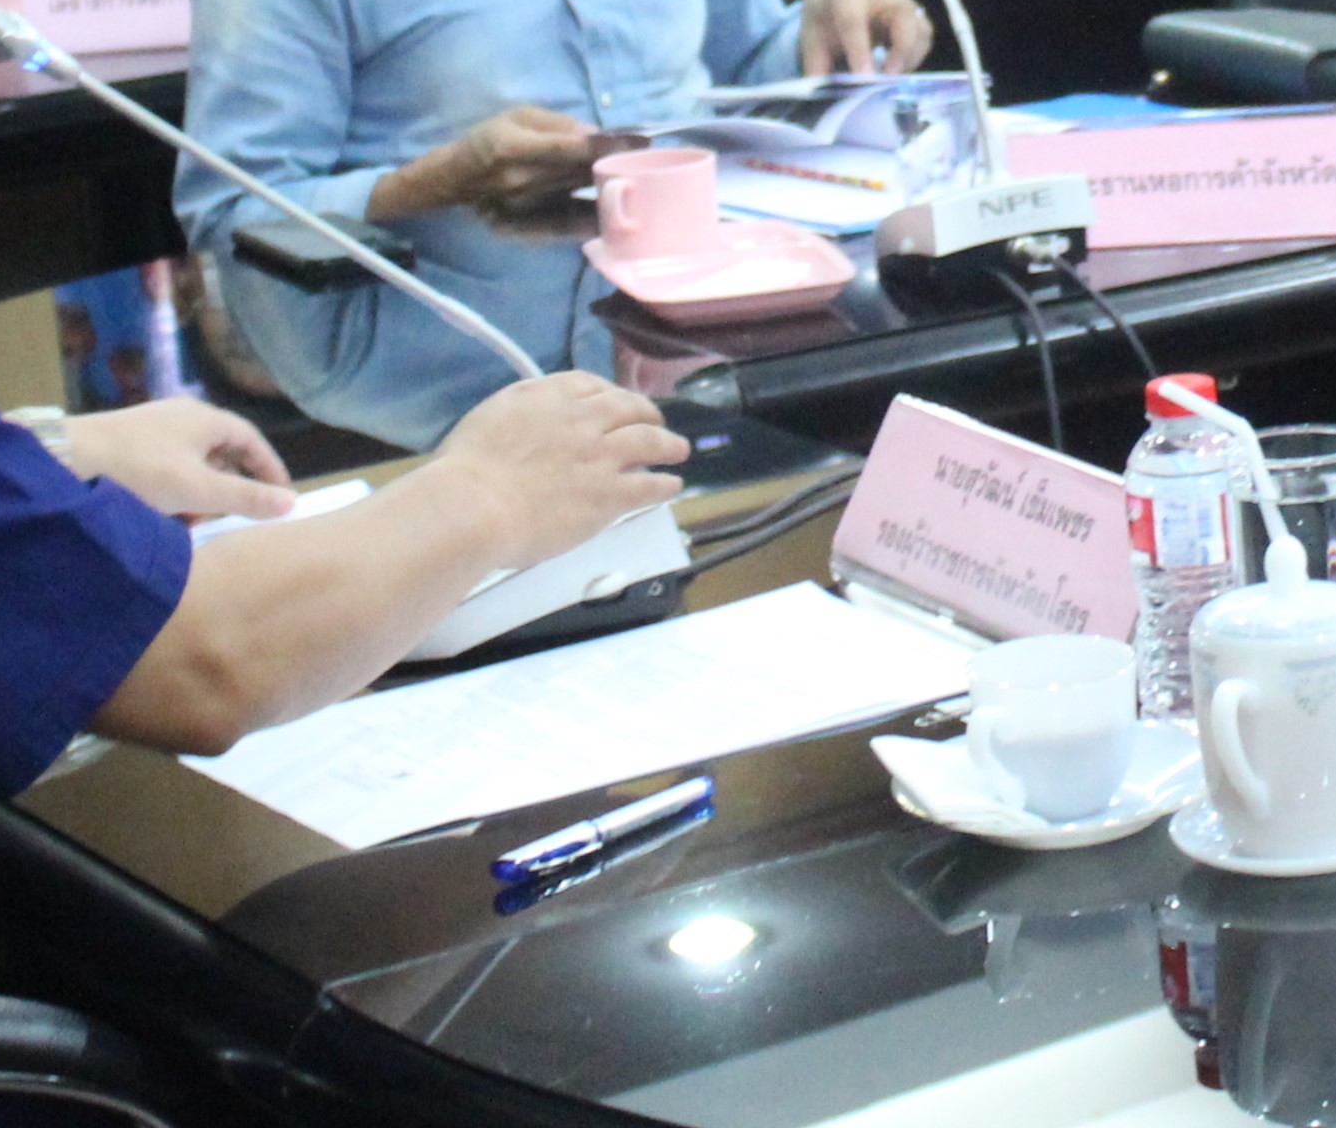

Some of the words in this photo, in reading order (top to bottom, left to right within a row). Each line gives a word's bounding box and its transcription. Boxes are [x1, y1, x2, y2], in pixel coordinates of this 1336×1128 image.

[978, 187, 1053, 218] NPE
[933, 455, 1028, 510] นายสุวัฒน์
[1018, 478, 1095, 542] เข็มเพชร
